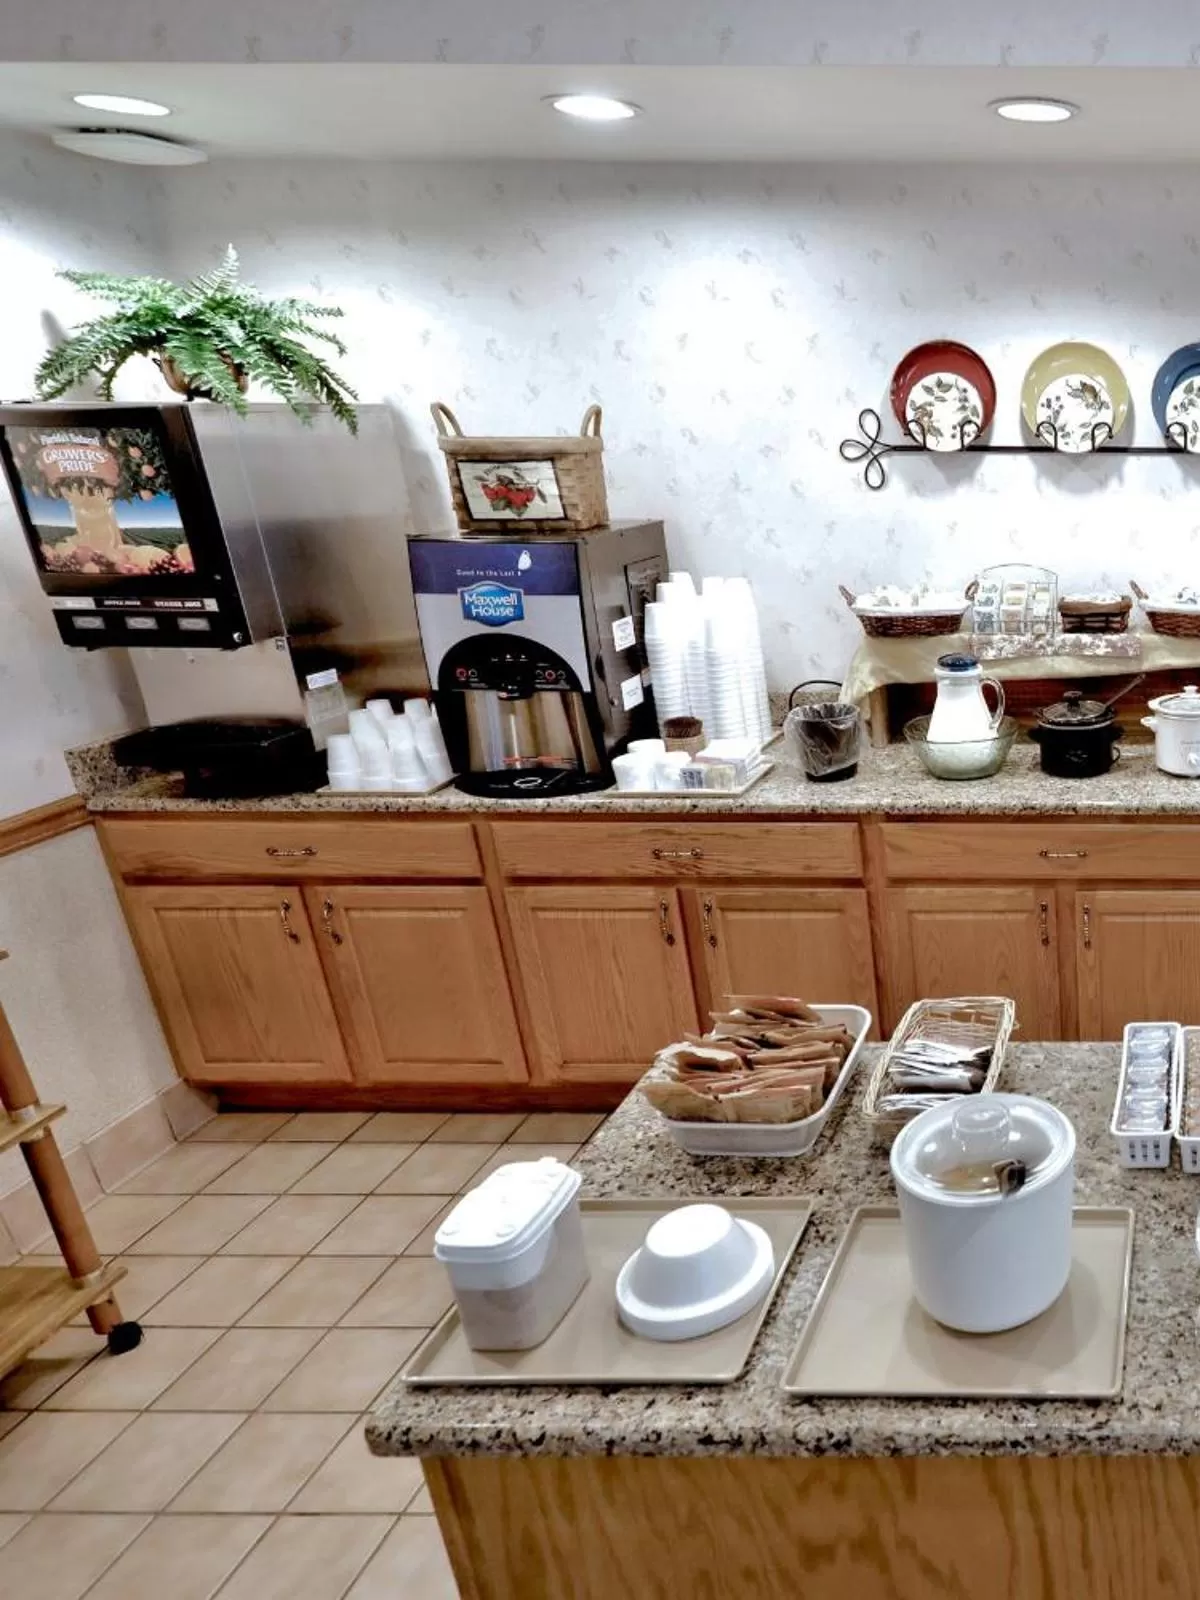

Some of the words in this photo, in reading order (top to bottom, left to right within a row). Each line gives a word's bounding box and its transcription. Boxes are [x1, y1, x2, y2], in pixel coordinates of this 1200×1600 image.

[58, 460, 97, 473] PRIDE
[463, 592, 518, 607] Maxwell
[471, 604, 515, 617] House
